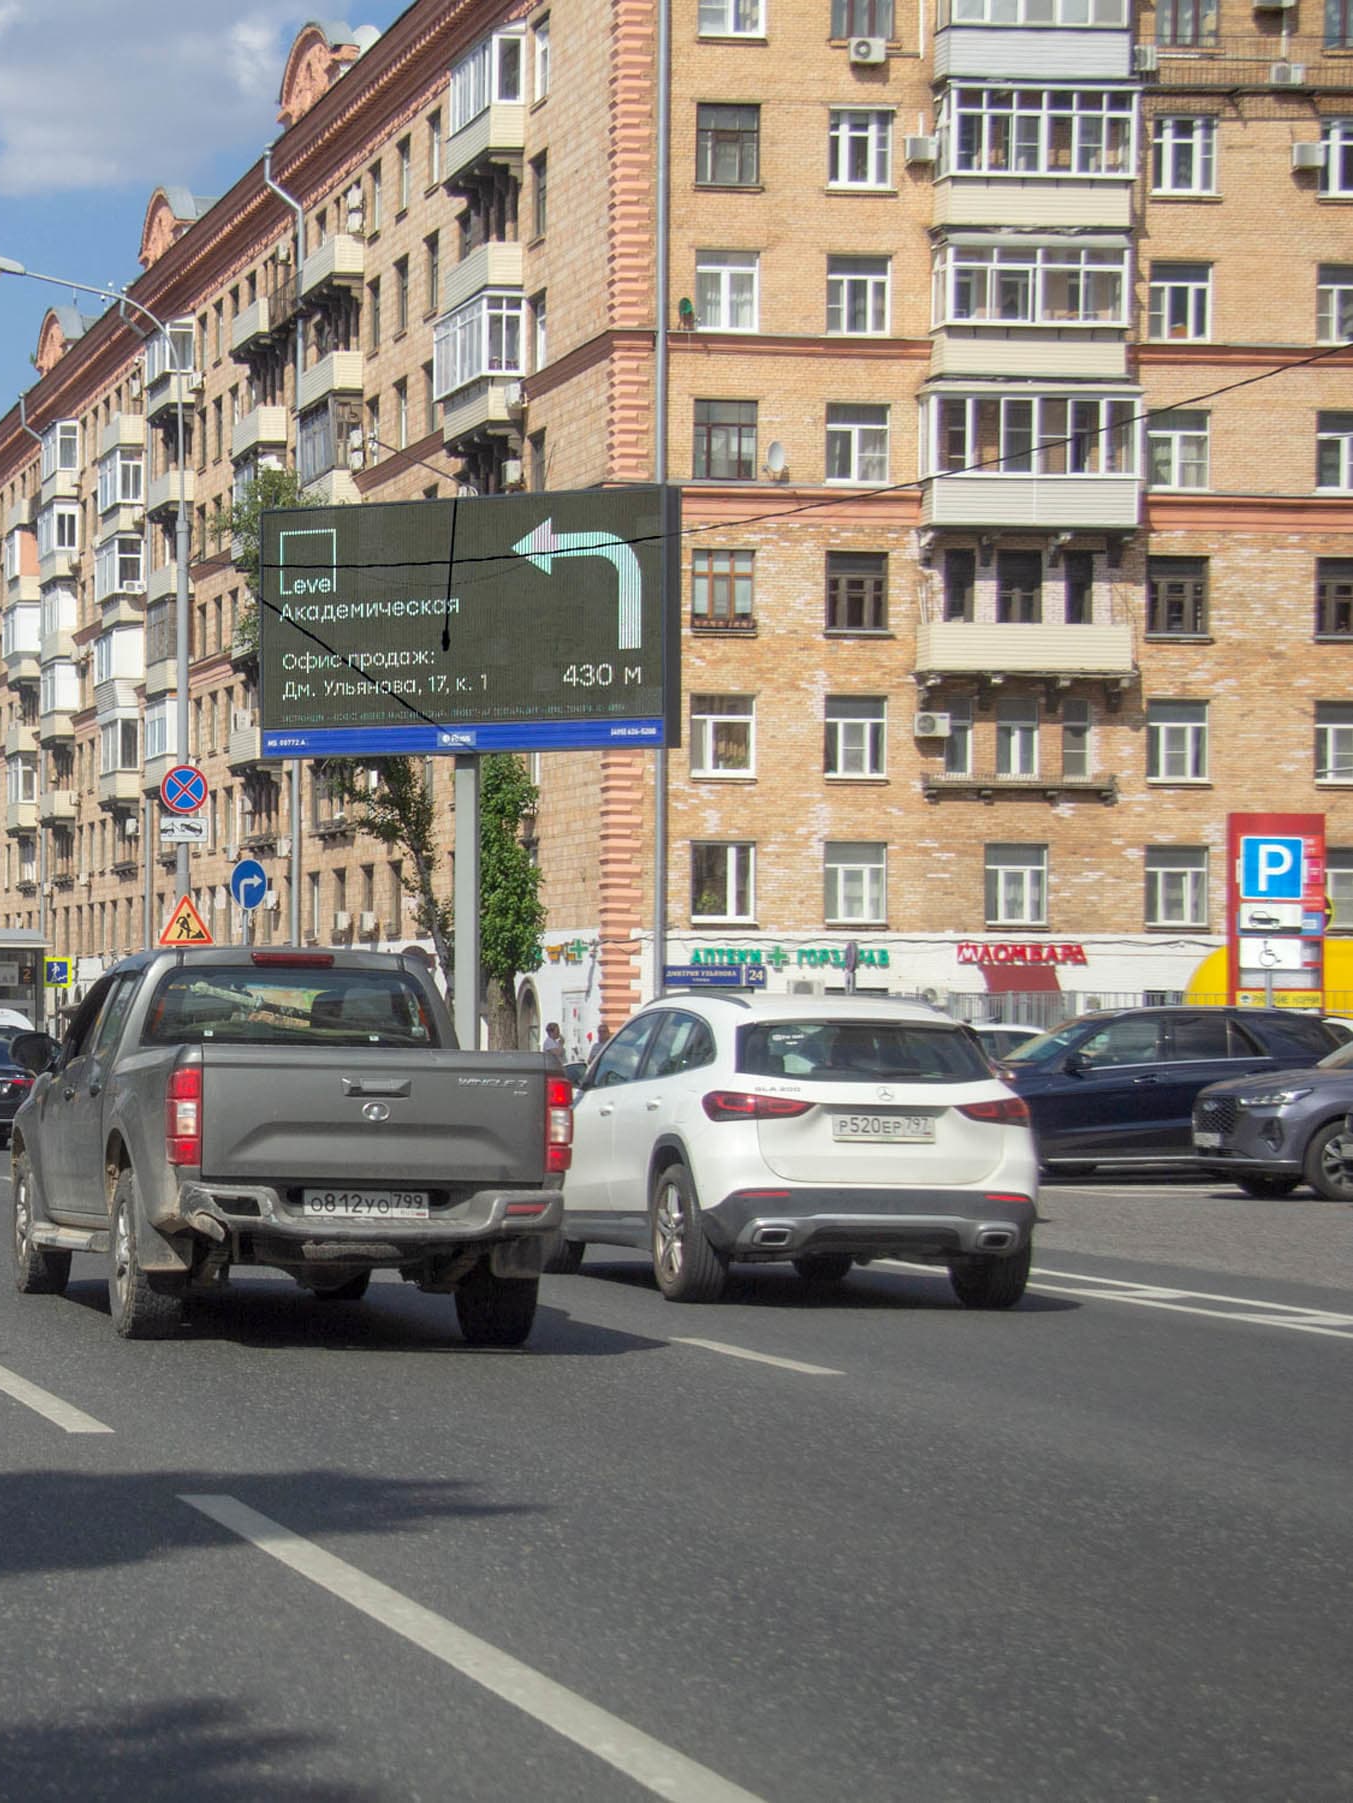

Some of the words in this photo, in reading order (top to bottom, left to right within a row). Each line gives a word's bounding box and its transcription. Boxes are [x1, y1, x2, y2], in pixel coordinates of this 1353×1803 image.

[279, 597, 460, 623] Академическая
[282, 651, 343, 674] Офис
[348, 650, 435, 672] продаж:
[563, 663, 613, 687] 430
[282, 681, 316, 701] Дм.
[324, 678, 422, 697] Ульянова,
[428, 675, 450, 694] 17,
[456, 677, 473, 692] к.
[480, 673, 487, 691] 1
[1258, 844, 1294, 892] P
[690, 947, 762, 965] АПТЕКИ
[797, 948, 890, 968] ГОРЗРАВ
[977, 944, 1088, 965] ЛОМБАРД
[23, 968, 32, 984] 2
[749, 969, 764, 981] 24
[392, 1194, 424, 1209] 799
